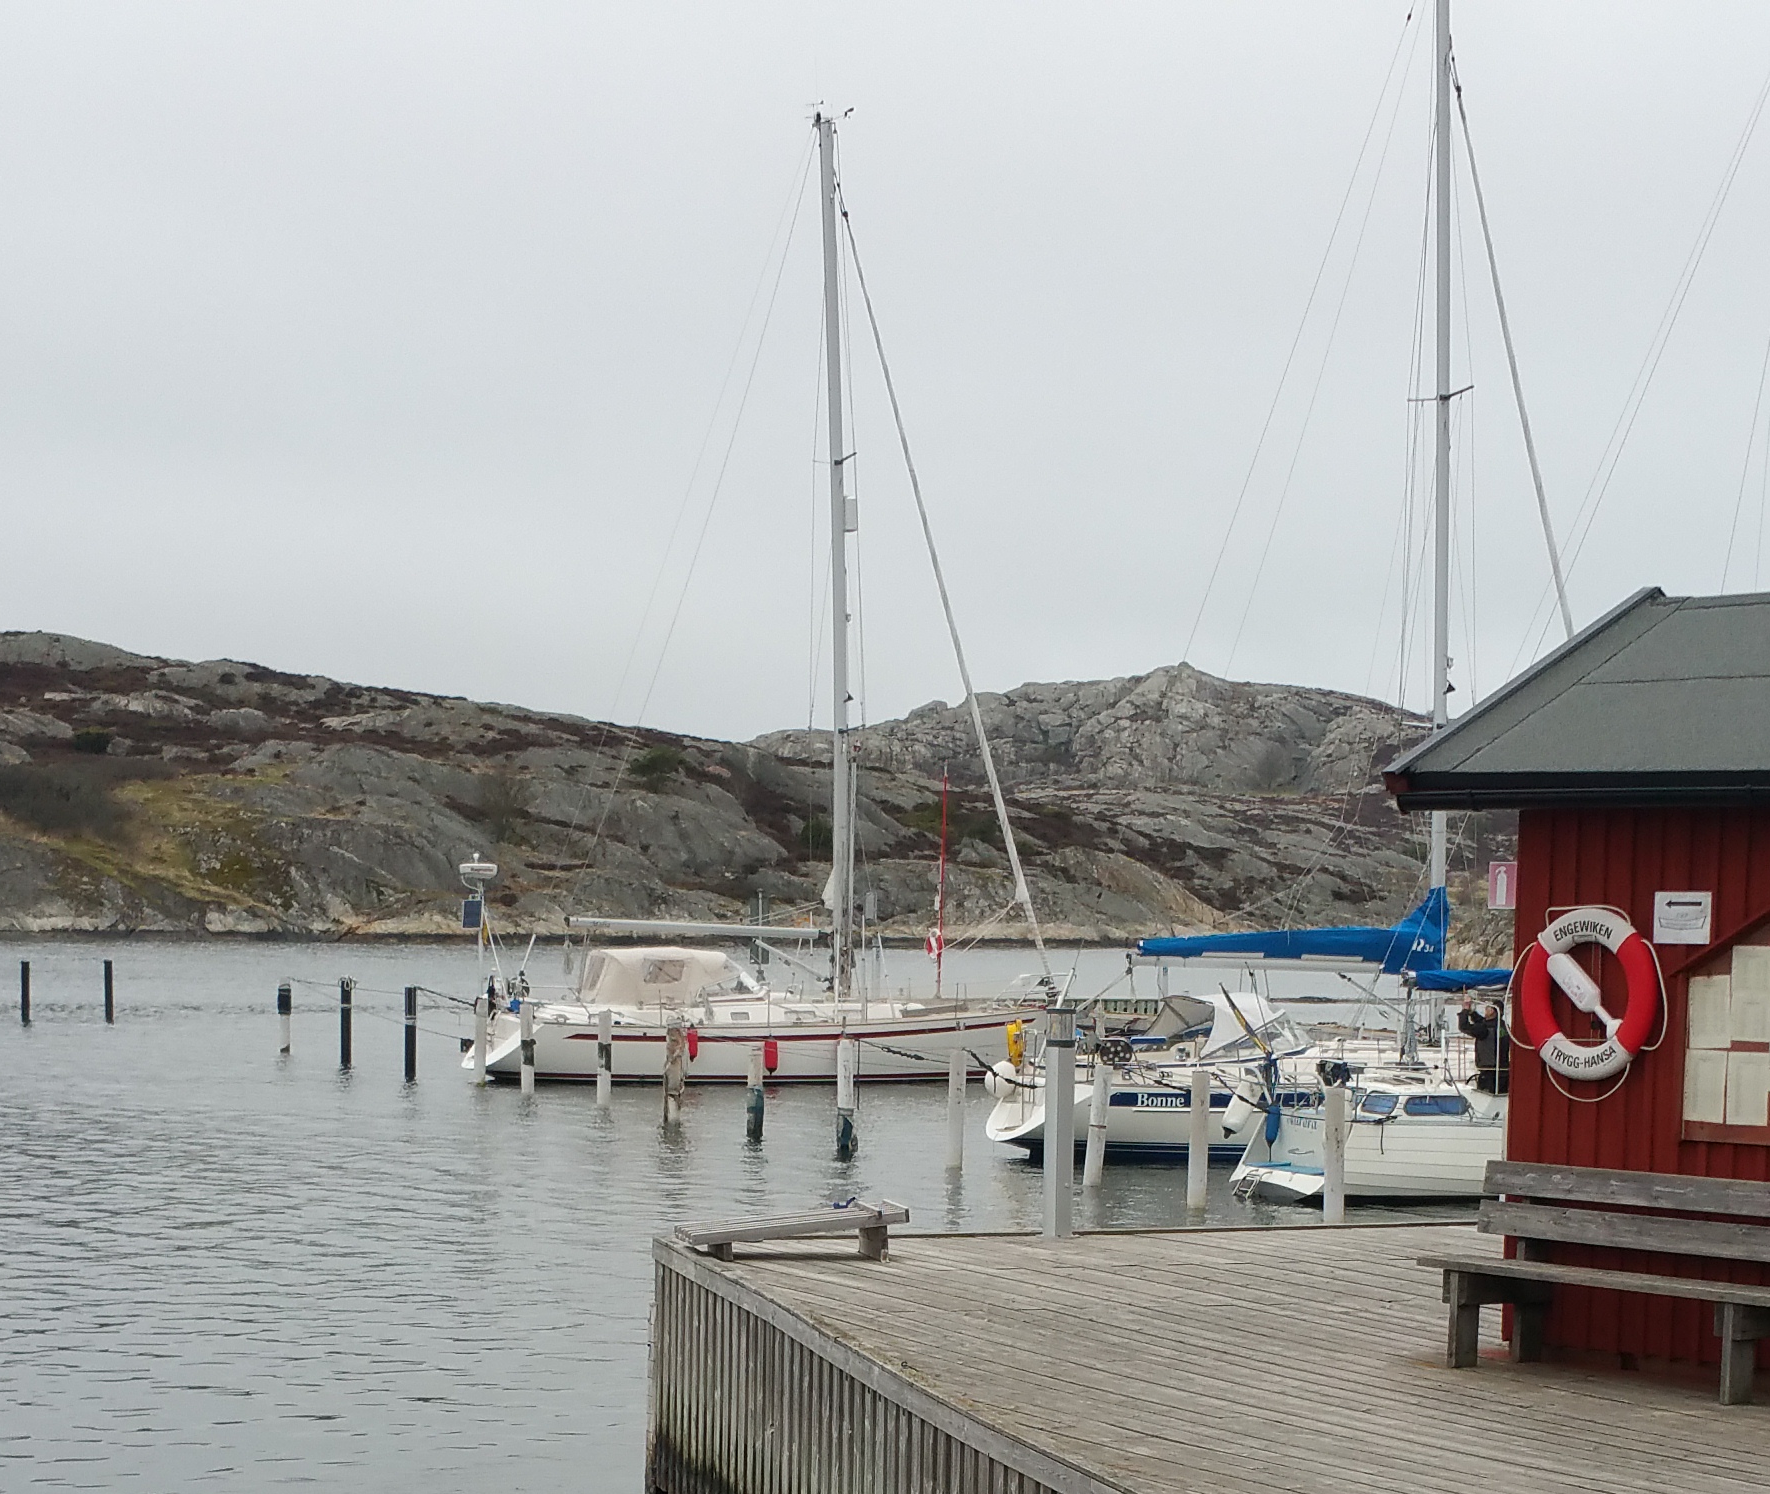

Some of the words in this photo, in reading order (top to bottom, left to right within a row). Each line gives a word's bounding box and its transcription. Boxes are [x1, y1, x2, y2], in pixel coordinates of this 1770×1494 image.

[1553, 920, 1613, 942] ENGEWIKEN
[1550, 1045, 1617, 1068] TRYGG-HANSA
[1136, 1093, 1185, 1107] Bonne
